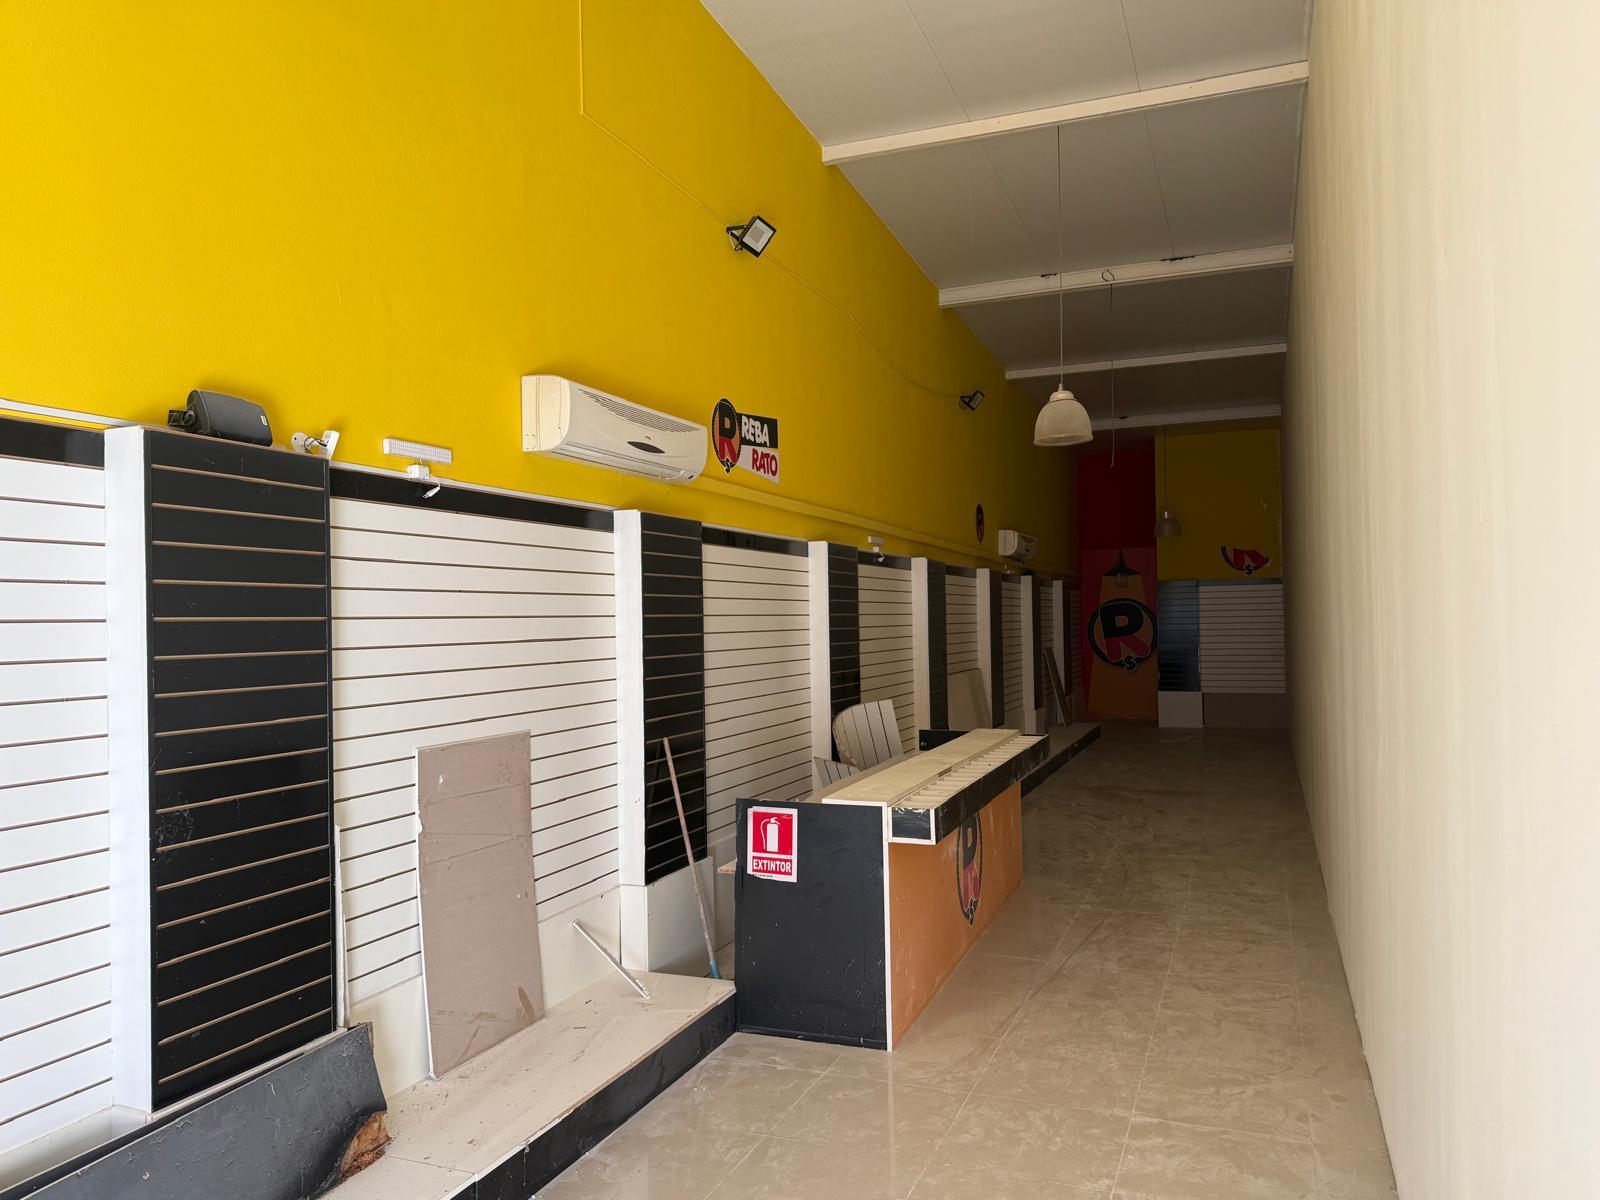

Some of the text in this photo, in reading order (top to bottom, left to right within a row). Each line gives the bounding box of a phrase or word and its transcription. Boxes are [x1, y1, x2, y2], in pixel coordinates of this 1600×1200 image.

[741, 415, 769, 447] REBA
[752, 448, 777, 477] RATO
[753, 859, 791, 873] EXTINTOR
